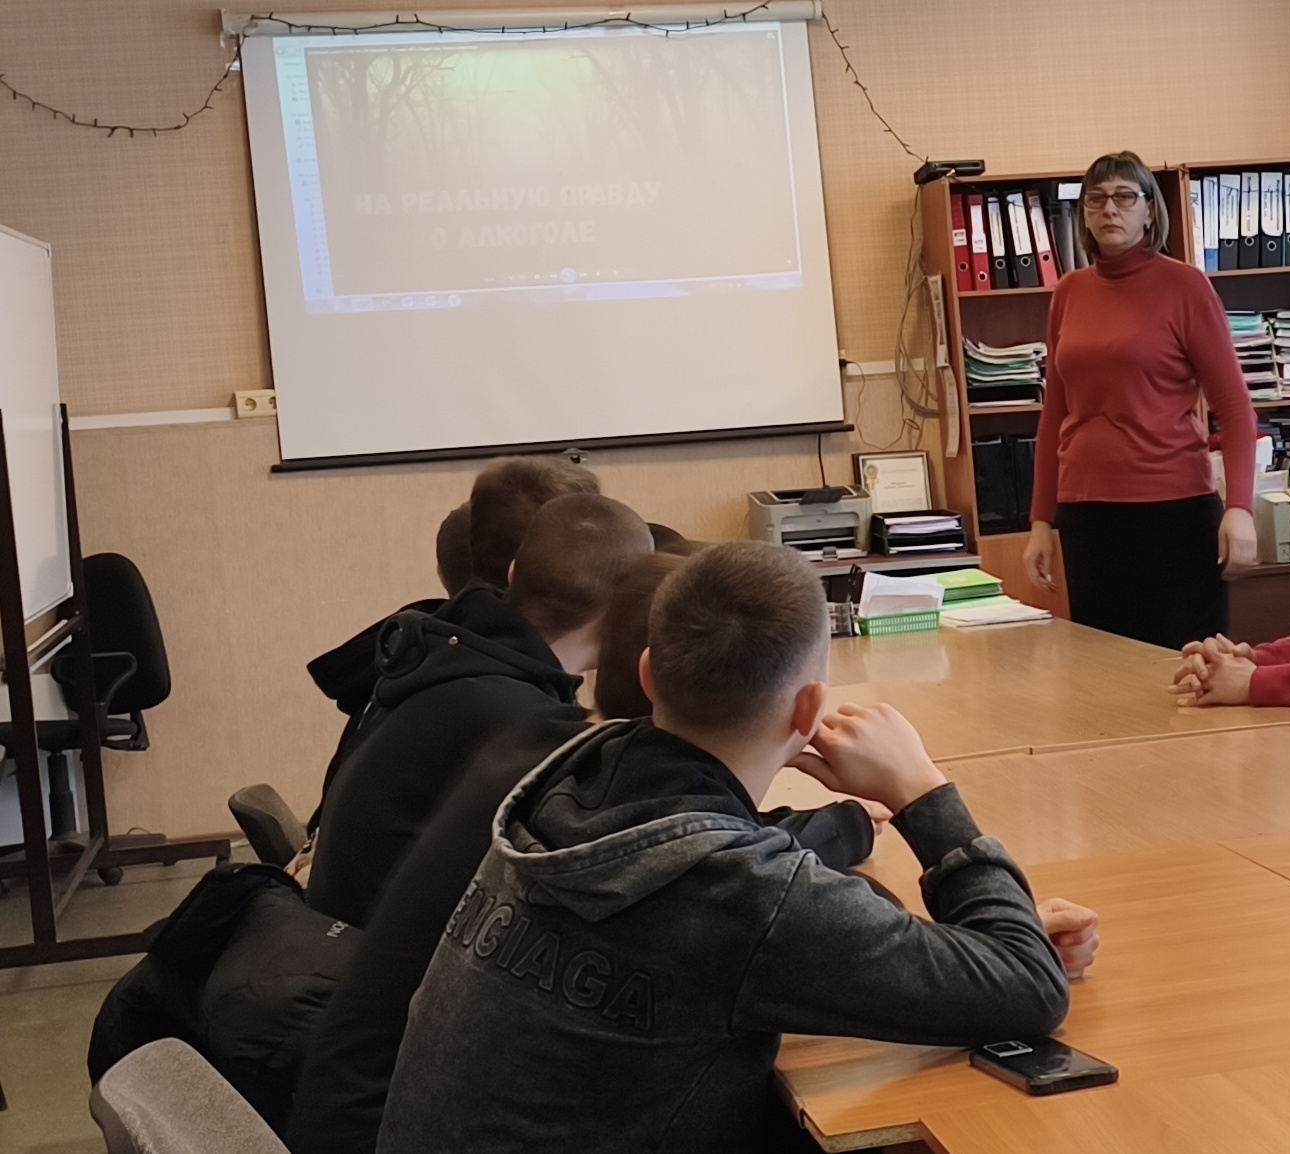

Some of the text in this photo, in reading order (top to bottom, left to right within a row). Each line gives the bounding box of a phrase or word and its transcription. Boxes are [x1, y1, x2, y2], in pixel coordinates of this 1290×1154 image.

[354, 180, 662, 216] НА РЕАЛЬНУЮ ПРАВДУ
[431, 219, 596, 249] О АЛКОГОЛЕ
